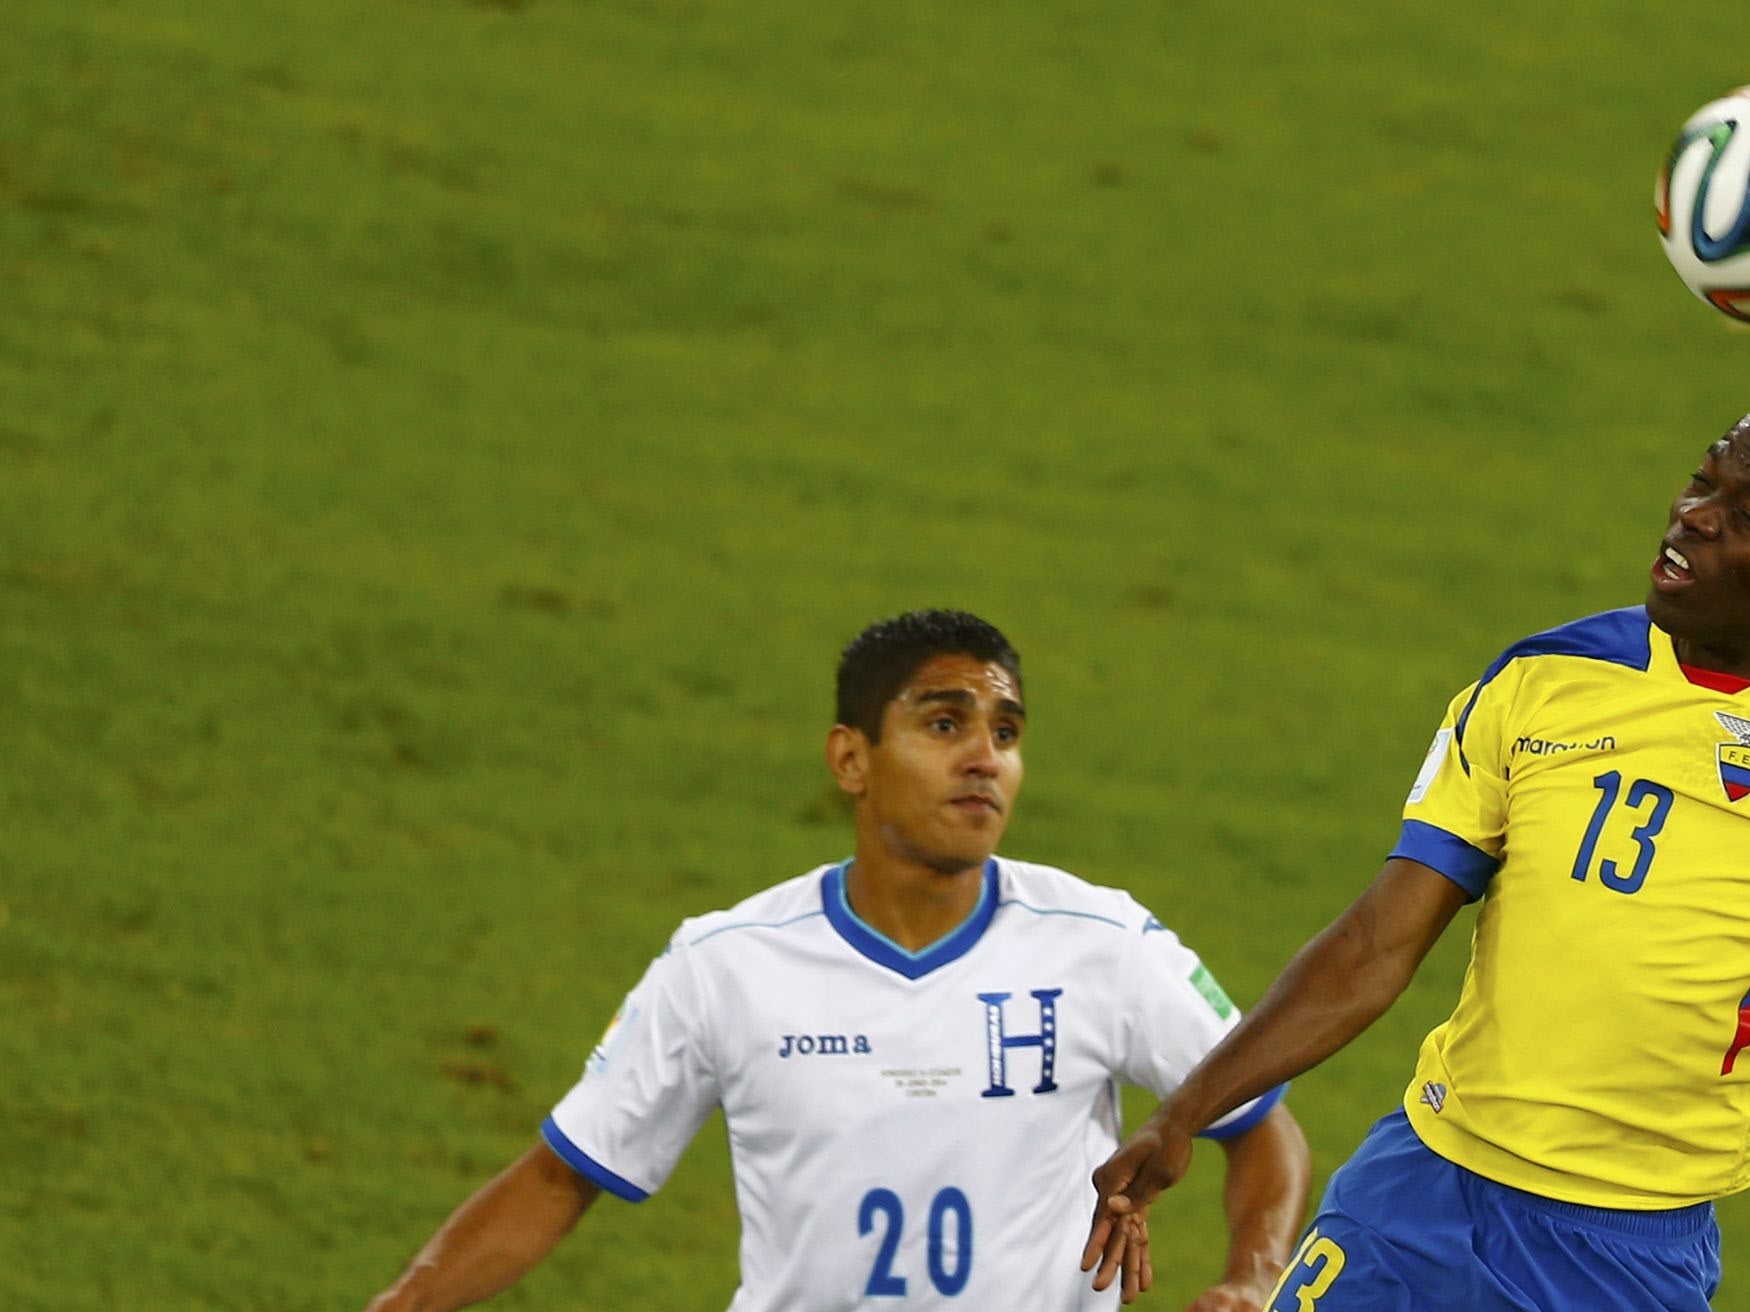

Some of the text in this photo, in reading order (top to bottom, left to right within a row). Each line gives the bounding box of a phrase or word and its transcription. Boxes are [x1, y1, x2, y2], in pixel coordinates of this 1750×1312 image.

[1571, 770, 1674, 894] 13
[976, 988, 1063, 1097] H
[858, 1186, 973, 1297] 20
